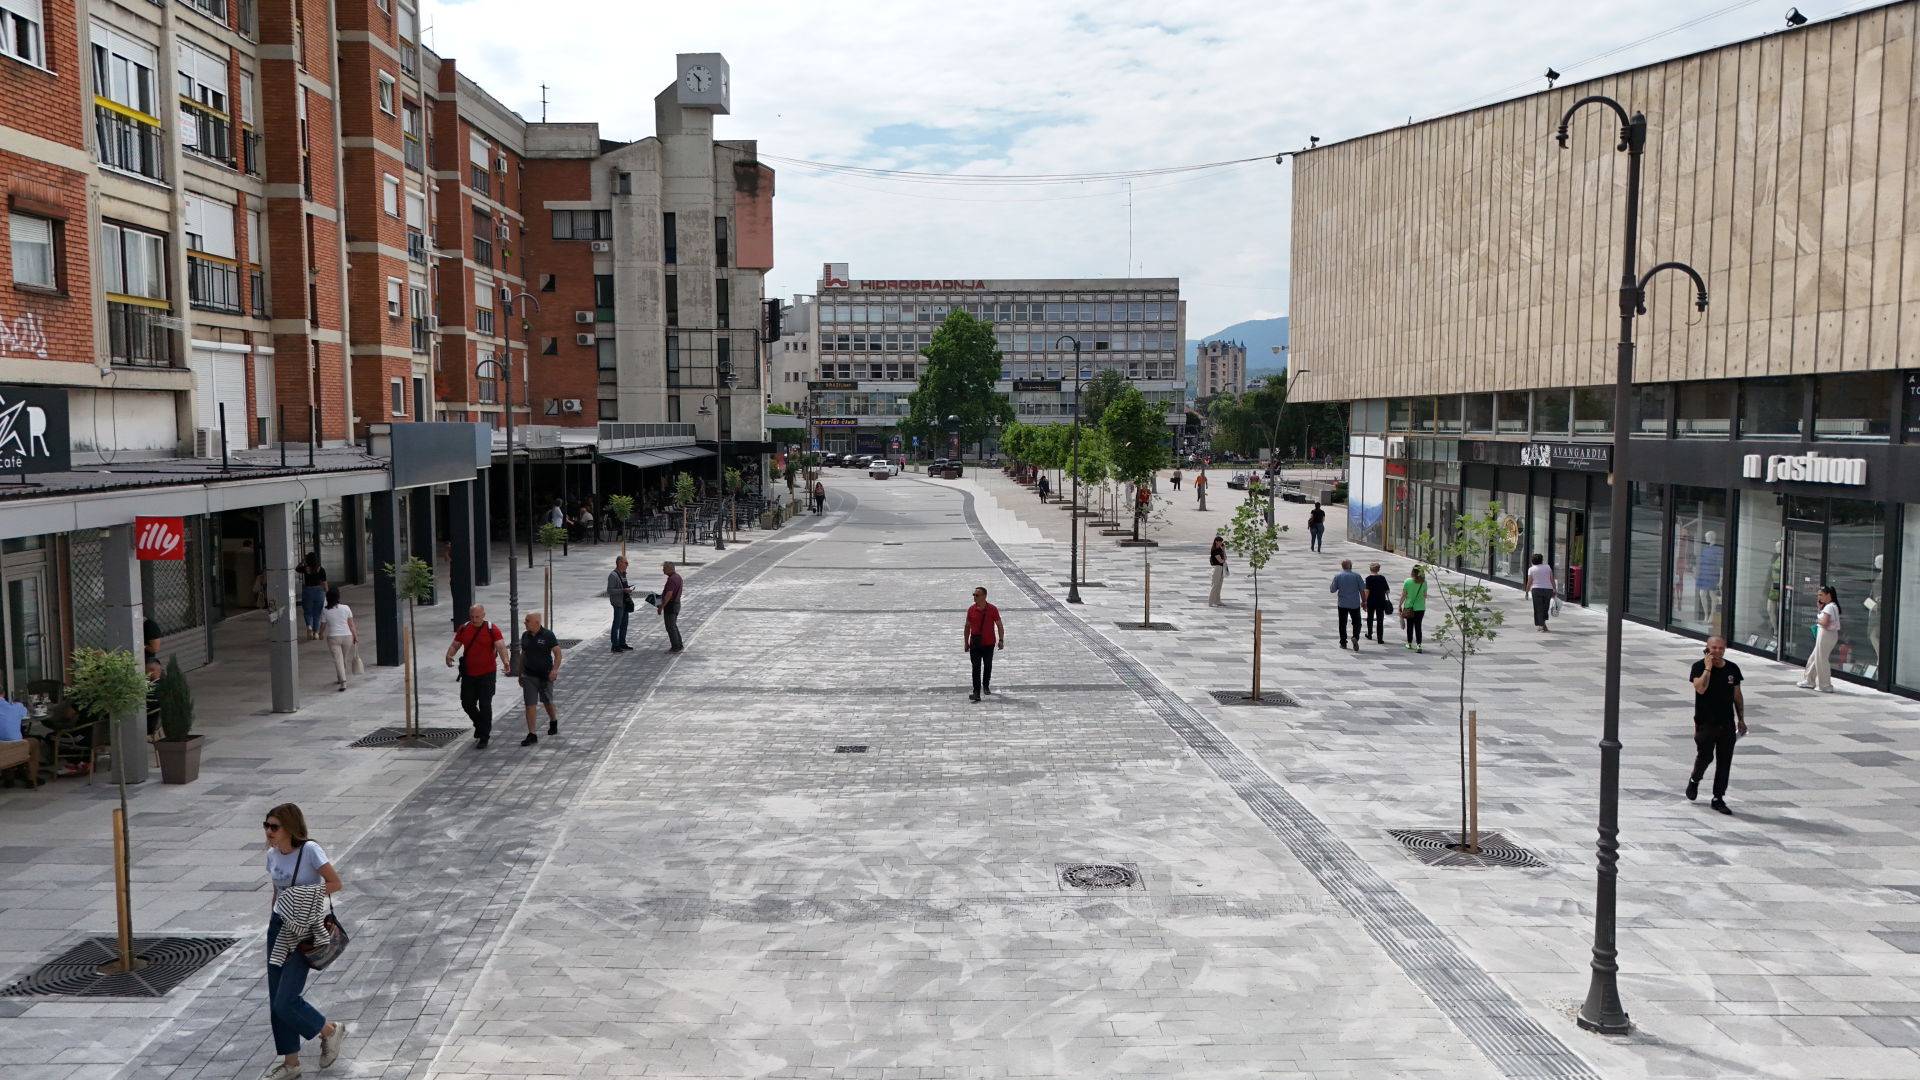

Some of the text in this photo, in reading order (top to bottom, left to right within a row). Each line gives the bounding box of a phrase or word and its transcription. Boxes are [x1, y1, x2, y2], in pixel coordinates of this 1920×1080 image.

[860, 279, 986, 290] HIDROGRADNJA
[1552, 447, 1607, 459] AVANGARDIA
[138, 522, 181, 557] illy
